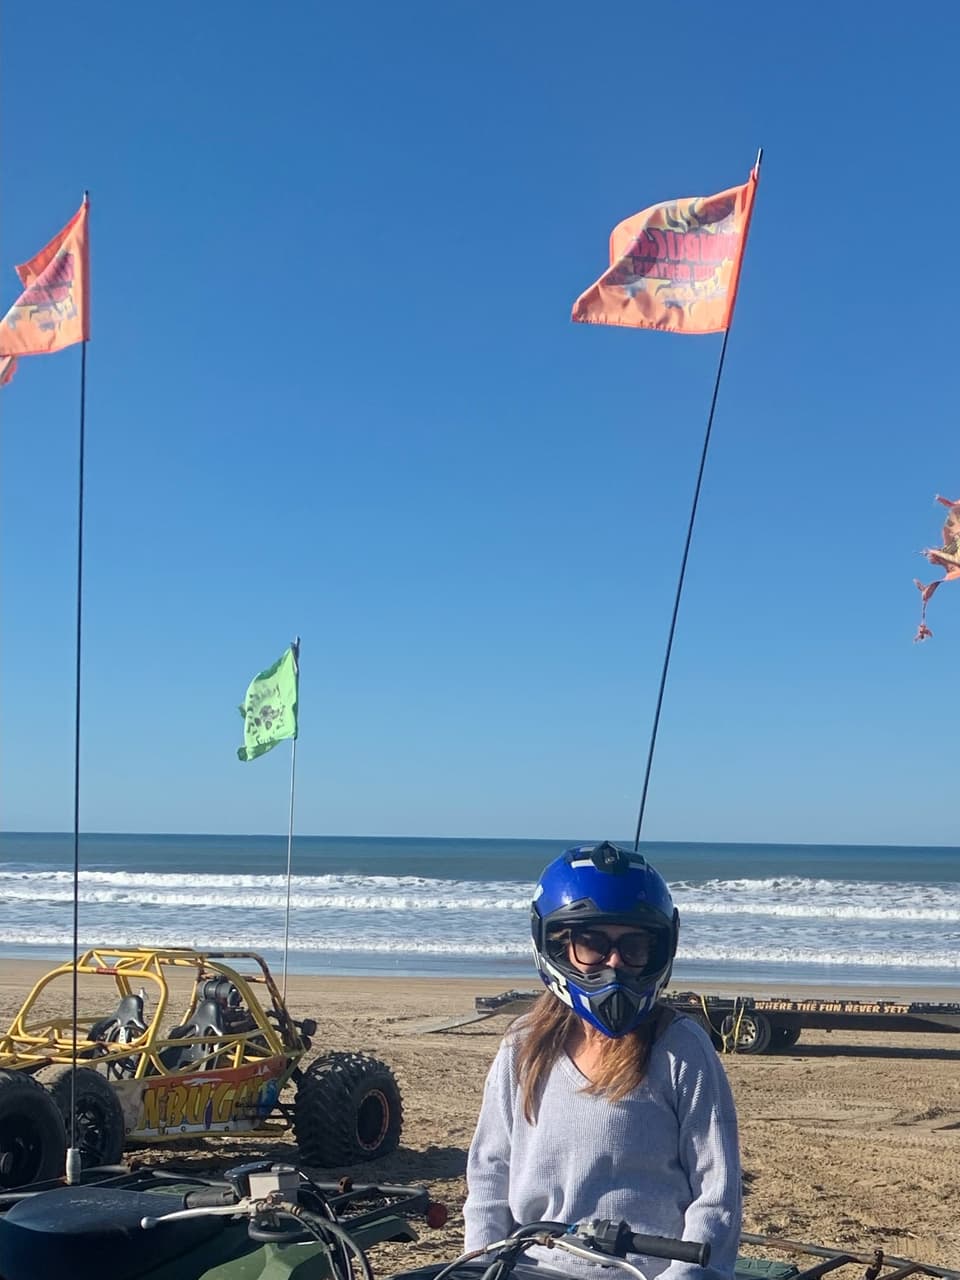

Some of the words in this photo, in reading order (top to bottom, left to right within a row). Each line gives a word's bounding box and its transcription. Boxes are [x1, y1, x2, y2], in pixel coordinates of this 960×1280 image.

[754, 1001, 793, 1011] WHERE
[796, 1002, 817, 1011] THE
[819, 1003, 842, 1012] FUN
[844, 1003, 881, 1013] NEVER
[883, 1005, 910, 1014] SETS
